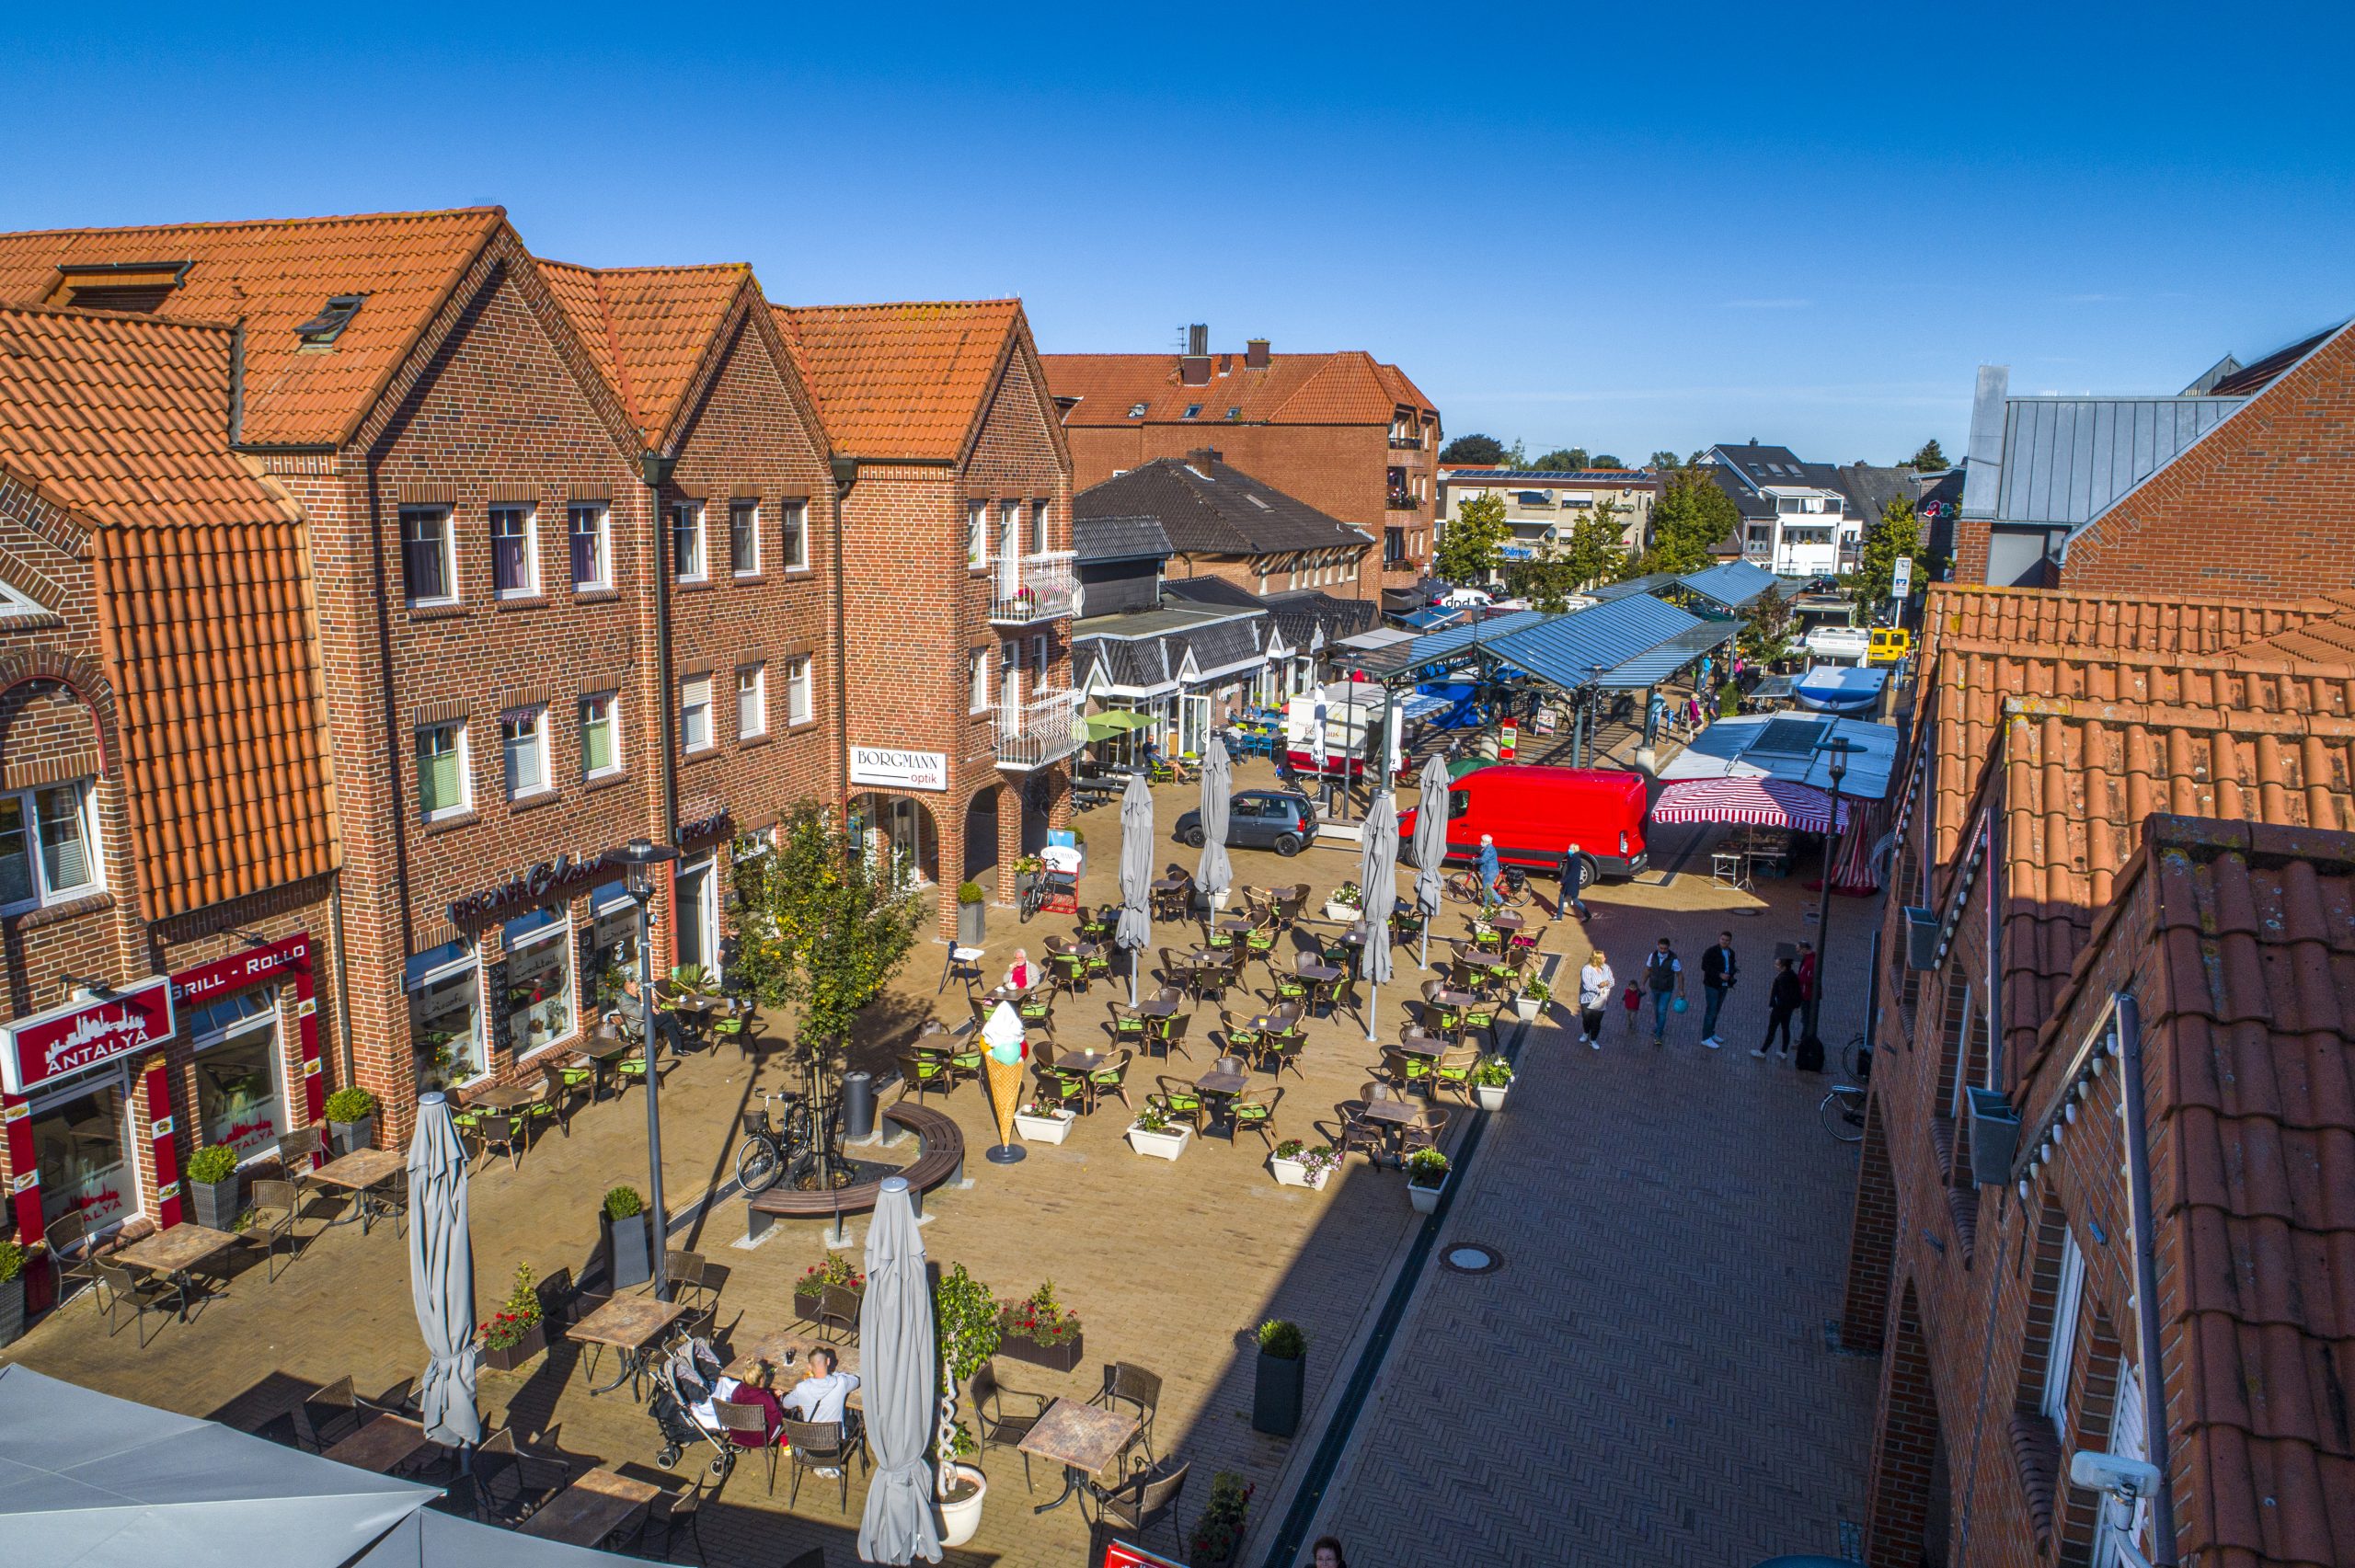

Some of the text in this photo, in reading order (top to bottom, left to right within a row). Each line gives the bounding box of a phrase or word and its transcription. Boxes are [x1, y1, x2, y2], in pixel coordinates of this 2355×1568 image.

[1445, 597, 1470, 608] dpd
[857, 750, 937, 770] BORGMANN
[911, 773, 937, 784] optik
[172, 973, 225, 1001] GRILL
[46, 1029, 149, 1075] ANTALYA
[234, 1129, 276, 1152] TALYA
